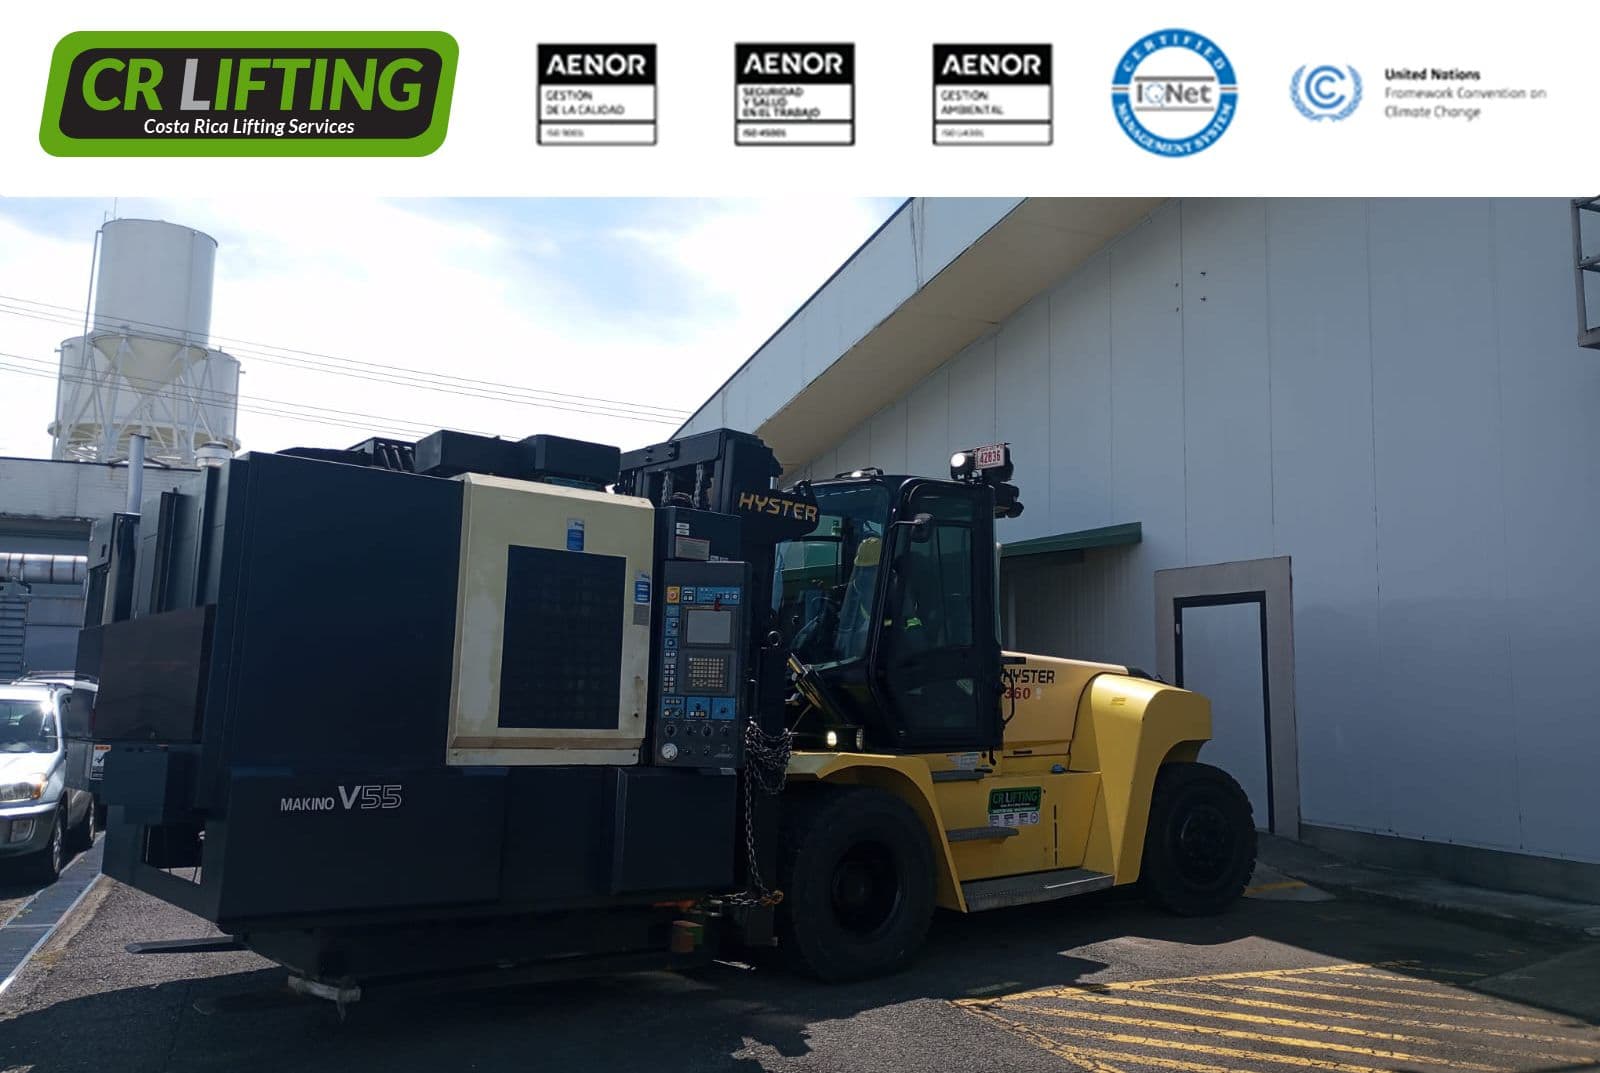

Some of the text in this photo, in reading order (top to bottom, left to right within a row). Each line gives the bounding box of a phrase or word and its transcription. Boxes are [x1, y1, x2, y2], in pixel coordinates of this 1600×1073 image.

[739, 492, 818, 522] HYSTER
[280, 784, 402, 811] MAKINO V55
